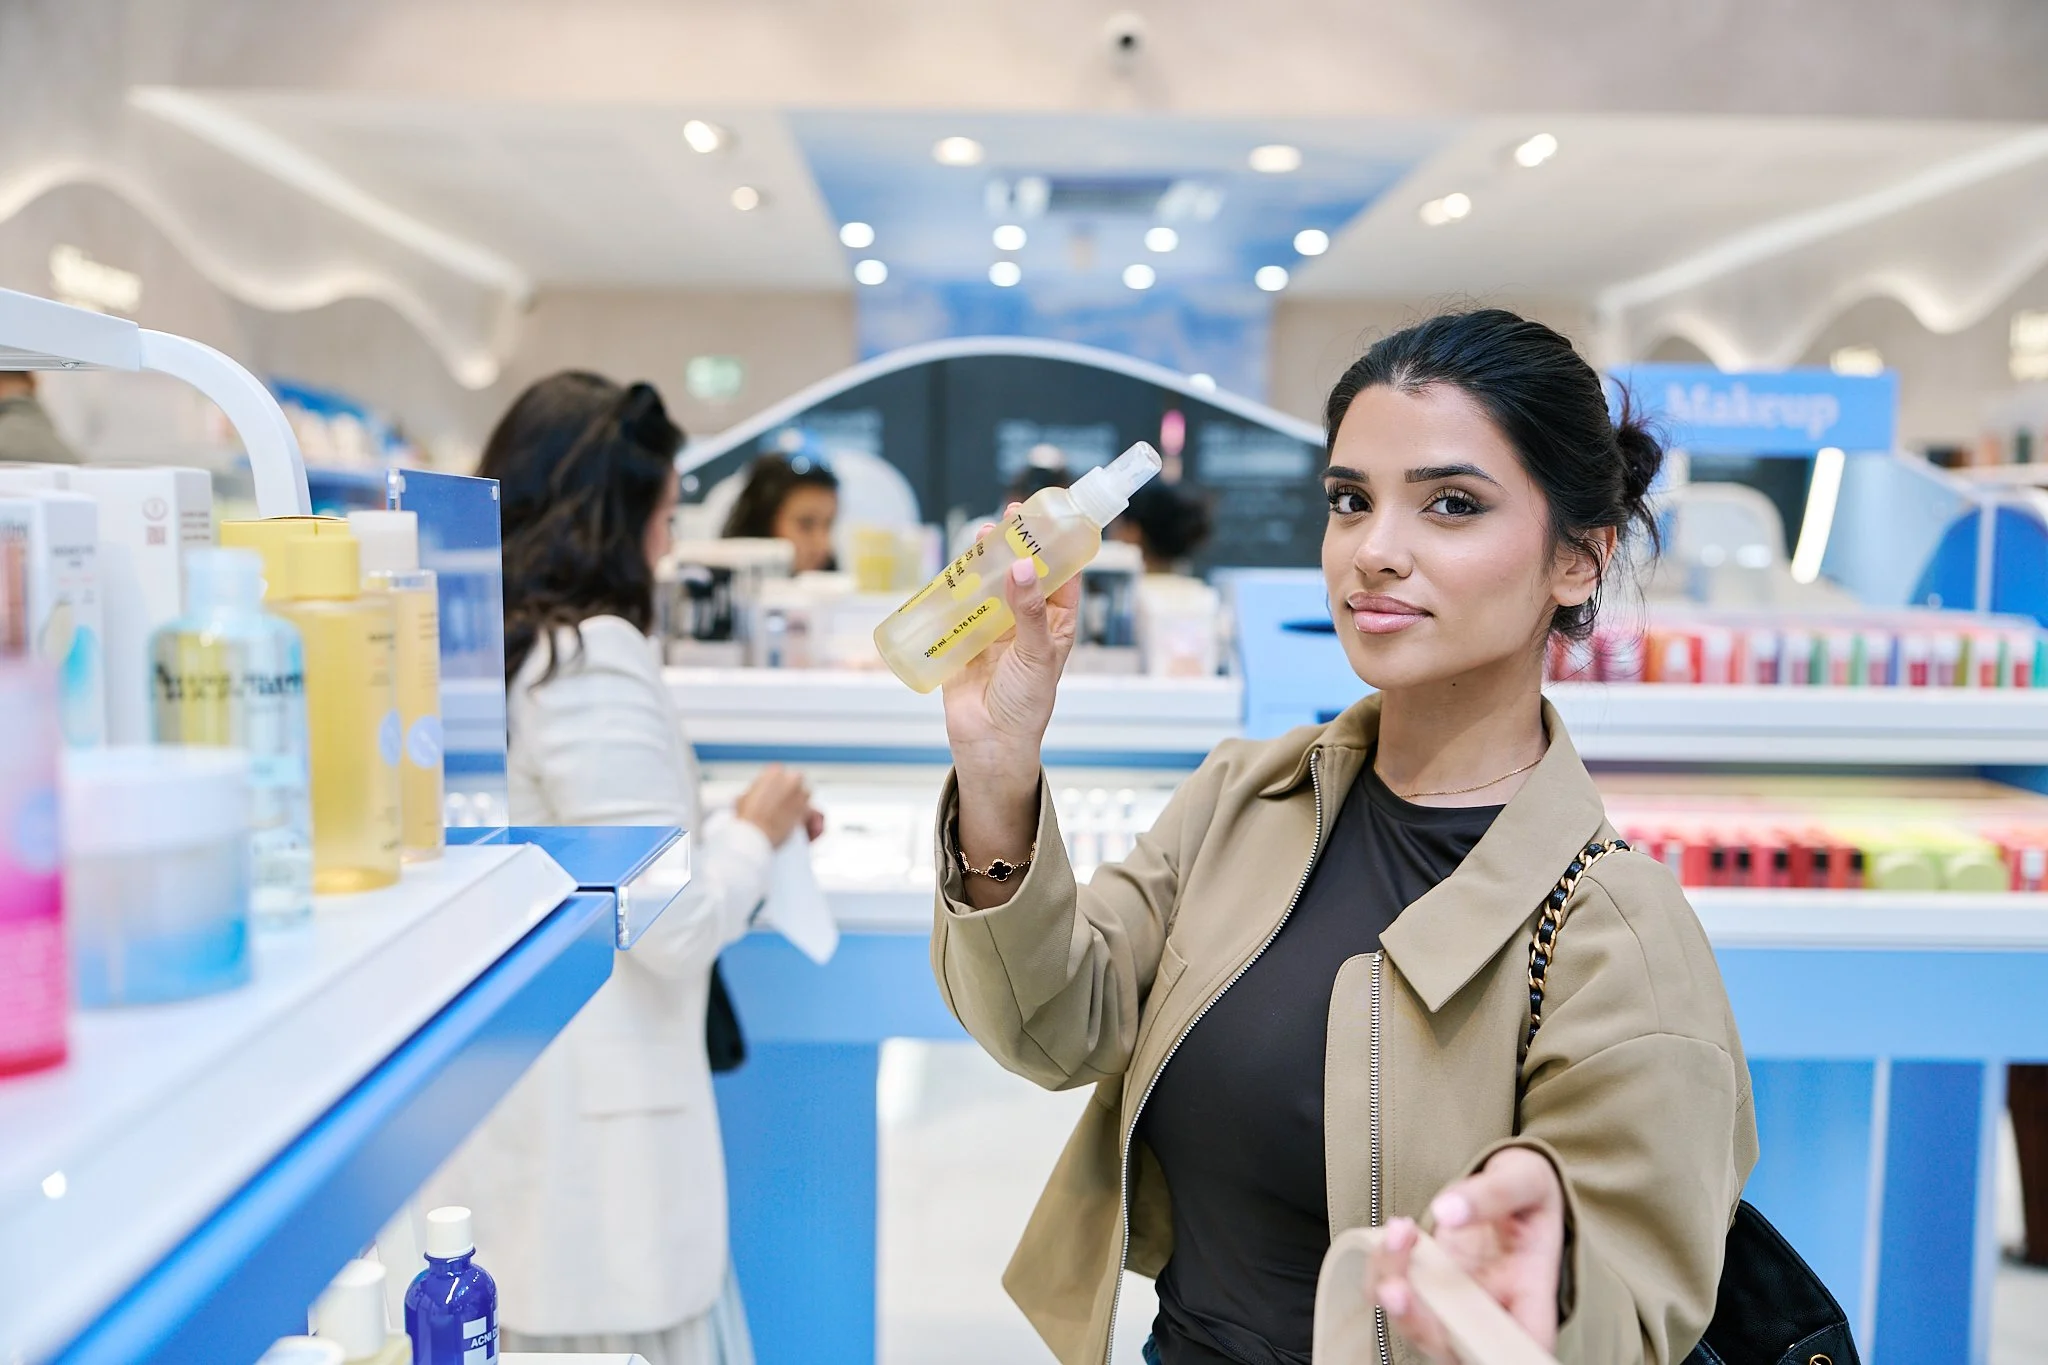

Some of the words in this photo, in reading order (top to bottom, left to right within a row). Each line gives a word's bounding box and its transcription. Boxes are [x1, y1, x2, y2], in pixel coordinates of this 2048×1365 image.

[1668, 382, 1839, 441] Makeup
[924, 646, 937, 658] 200
[937, 638, 947, 648] ml
[953, 621, 968, 635] 6.76
[471, 1331, 492, 1348] ACNI
